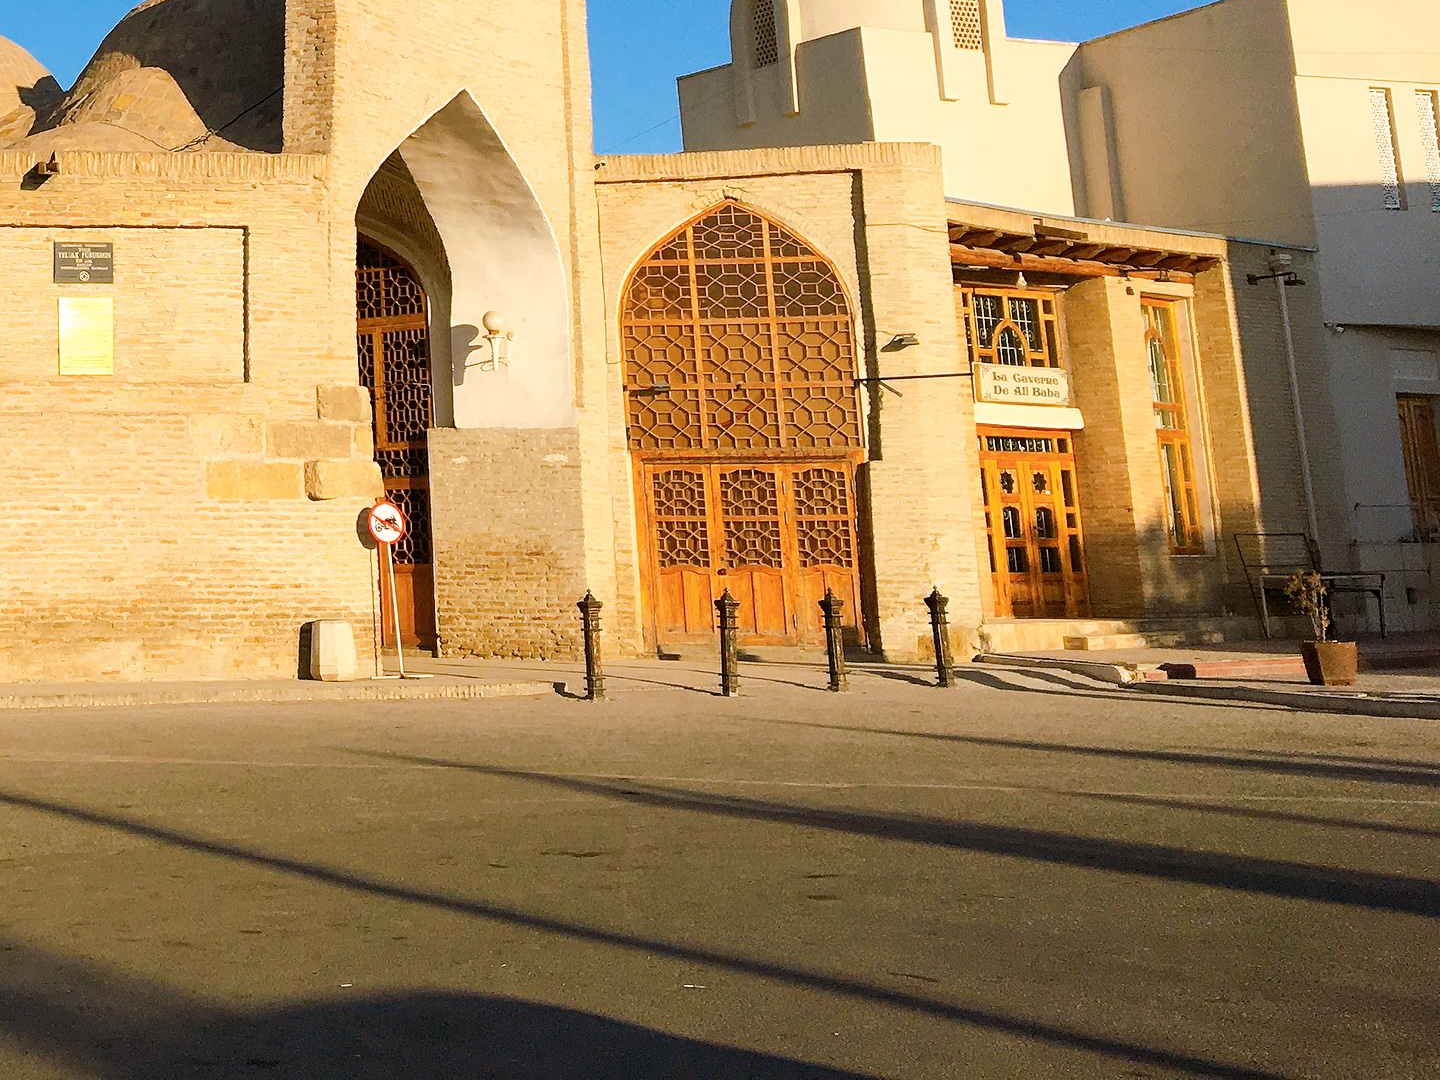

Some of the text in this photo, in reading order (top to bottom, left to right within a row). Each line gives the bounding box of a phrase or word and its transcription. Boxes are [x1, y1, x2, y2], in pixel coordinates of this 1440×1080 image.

[992, 372, 1059, 386] La Caverne
[993, 385, 1060, 398] De Ali Baba
